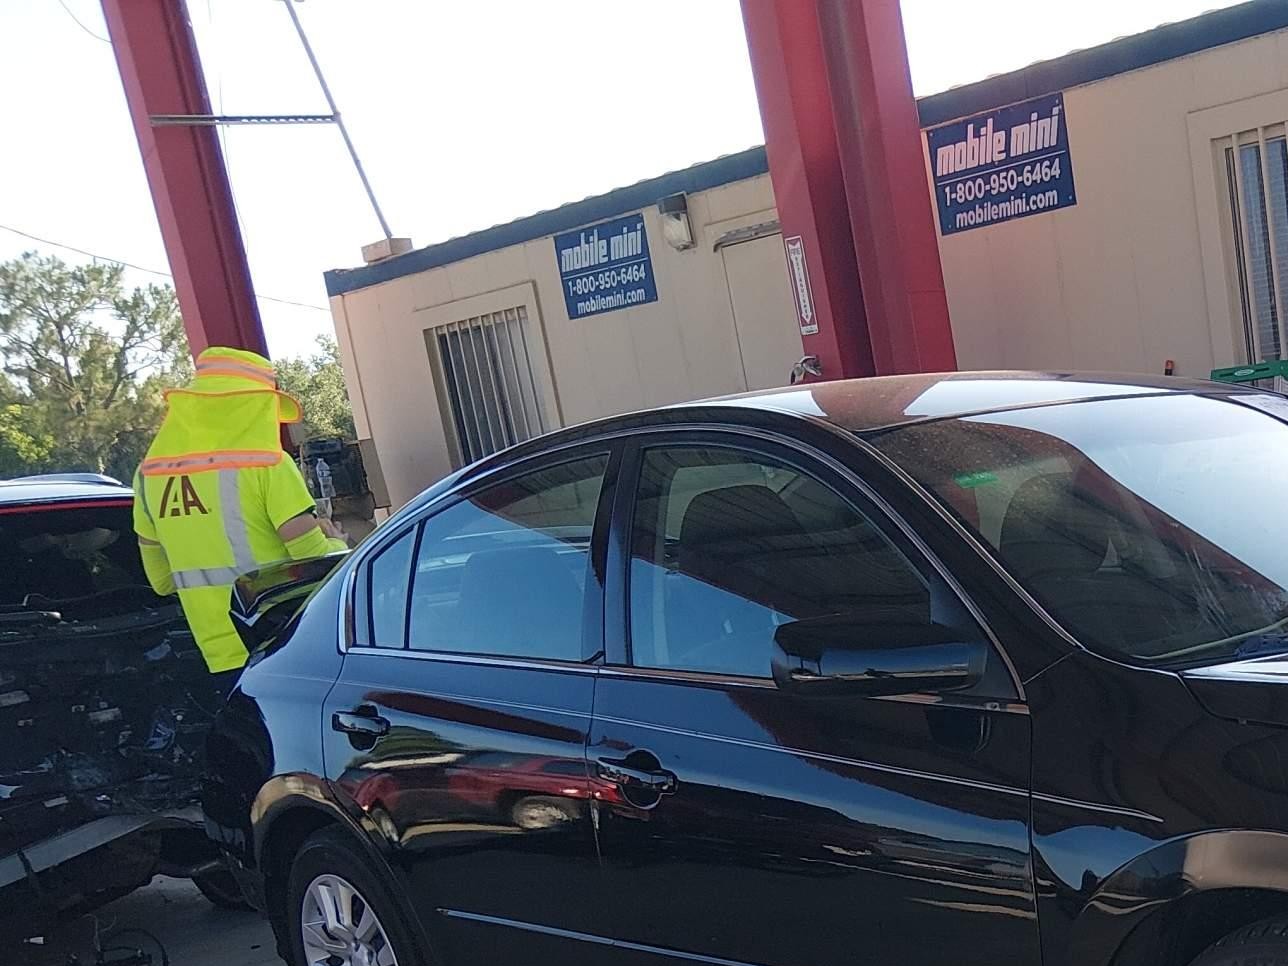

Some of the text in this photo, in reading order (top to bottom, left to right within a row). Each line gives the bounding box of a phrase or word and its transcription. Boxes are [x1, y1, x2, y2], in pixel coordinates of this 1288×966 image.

[937, 106, 1059, 177] mobile mini
[944, 158, 1061, 207] 1-800-950-6464
[956, 189, 1058, 229] mobilemini.com
[561, 223, 642, 273] mobile mini
[568, 263, 646, 297] 1-800-950-6464
[577, 288, 646, 315] mobilemini.com
